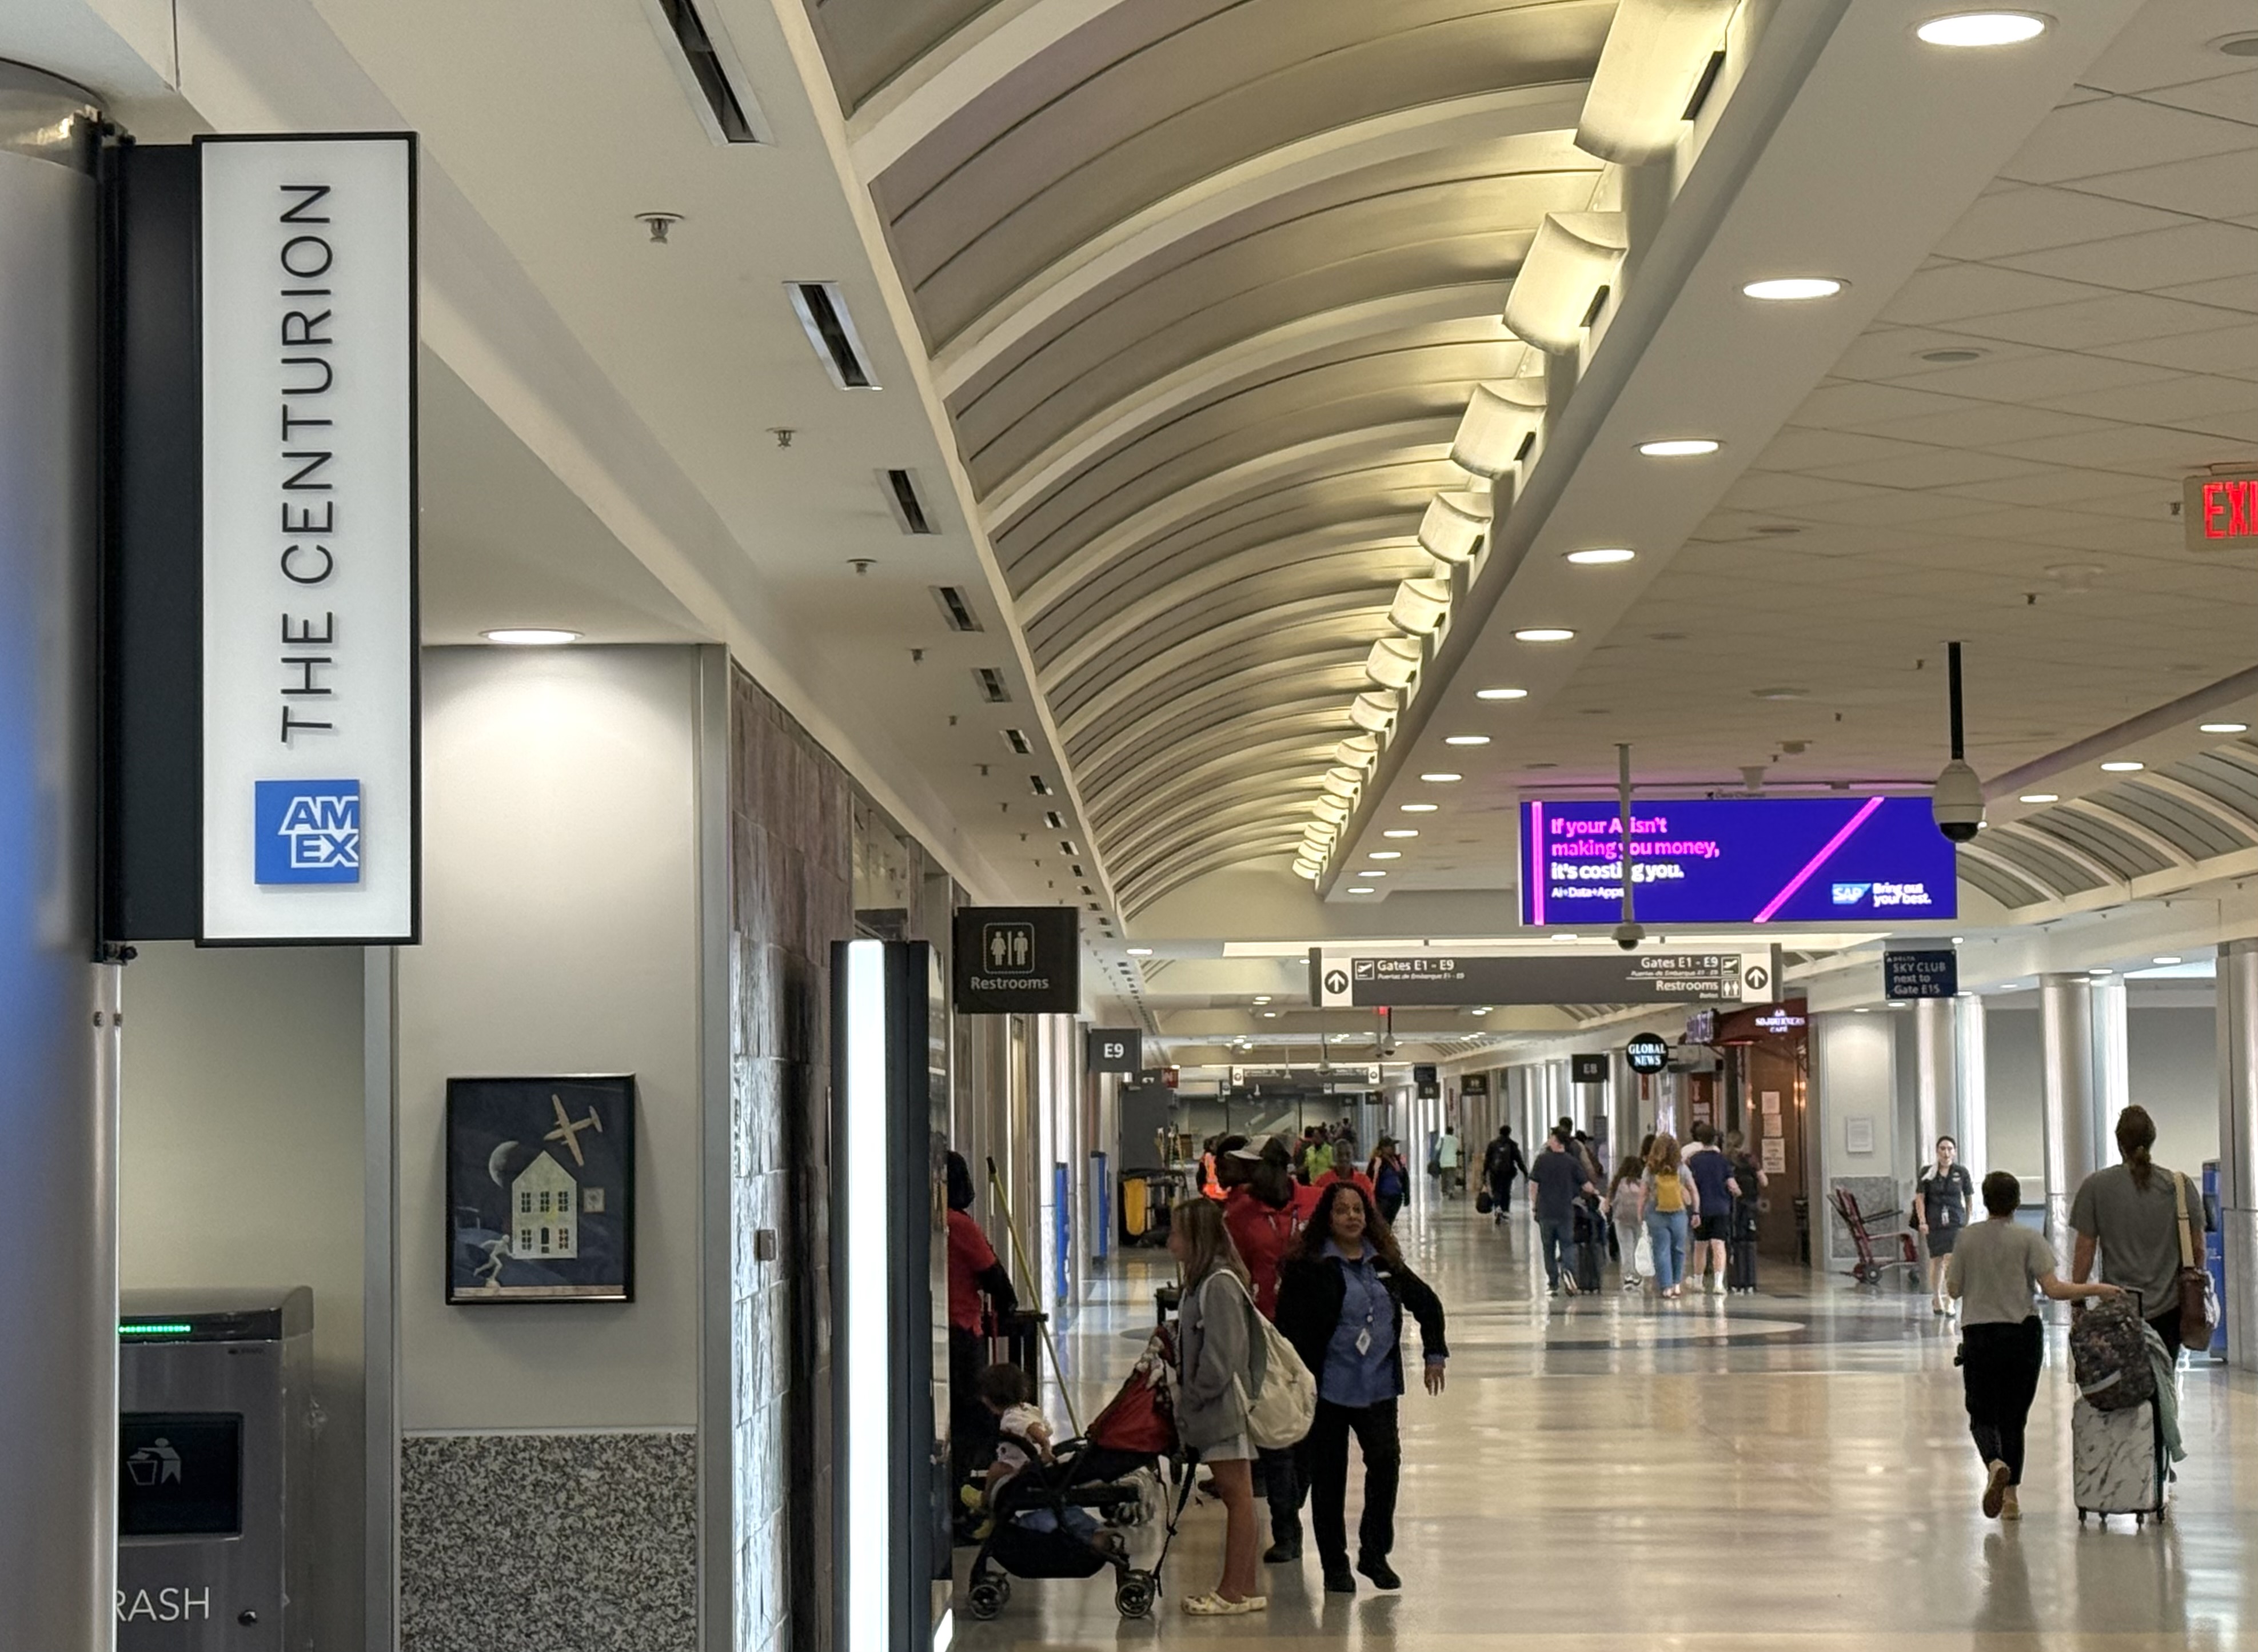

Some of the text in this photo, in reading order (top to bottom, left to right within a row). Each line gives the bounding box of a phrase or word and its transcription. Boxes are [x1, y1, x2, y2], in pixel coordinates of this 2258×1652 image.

[280, 184, 333, 744] THE CENTURION
[2204, 481, 2258, 538] EXI
[1551, 817, 1667, 837] If your A isn't
[1551, 840, 1617, 860] making
[1654, 841, 1720, 859] money,
[1551, 861, 1685, 882] it's costig you.
[1833, 887, 1864, 901] SAP
[1904, 883, 1924, 894] out
[1377, 960, 1411, 971] Gates
[1414, 960, 1428, 971] E1
[1439, 960, 1455, 971] E9
[1641, 957, 1675, 968] Gates
[1678, 957, 1691, 968] E1
[1704, 956, 1718, 968] E9
[1893, 961, 1946, 973] SKY CLUB
[970, 976, 1050, 990] Restrooms
[1655, 980, 1719, 991] Restrooms
[1893, 974, 1931, 983] next to
[1894, 985, 1919, 995] Gate
[1104, 1043, 1124, 1058] E9
[1628, 1043, 1666, 1055] GLOBAL
[1634, 1055, 1661, 1066] NEWS
[116, 1586, 210, 1622] RASH
